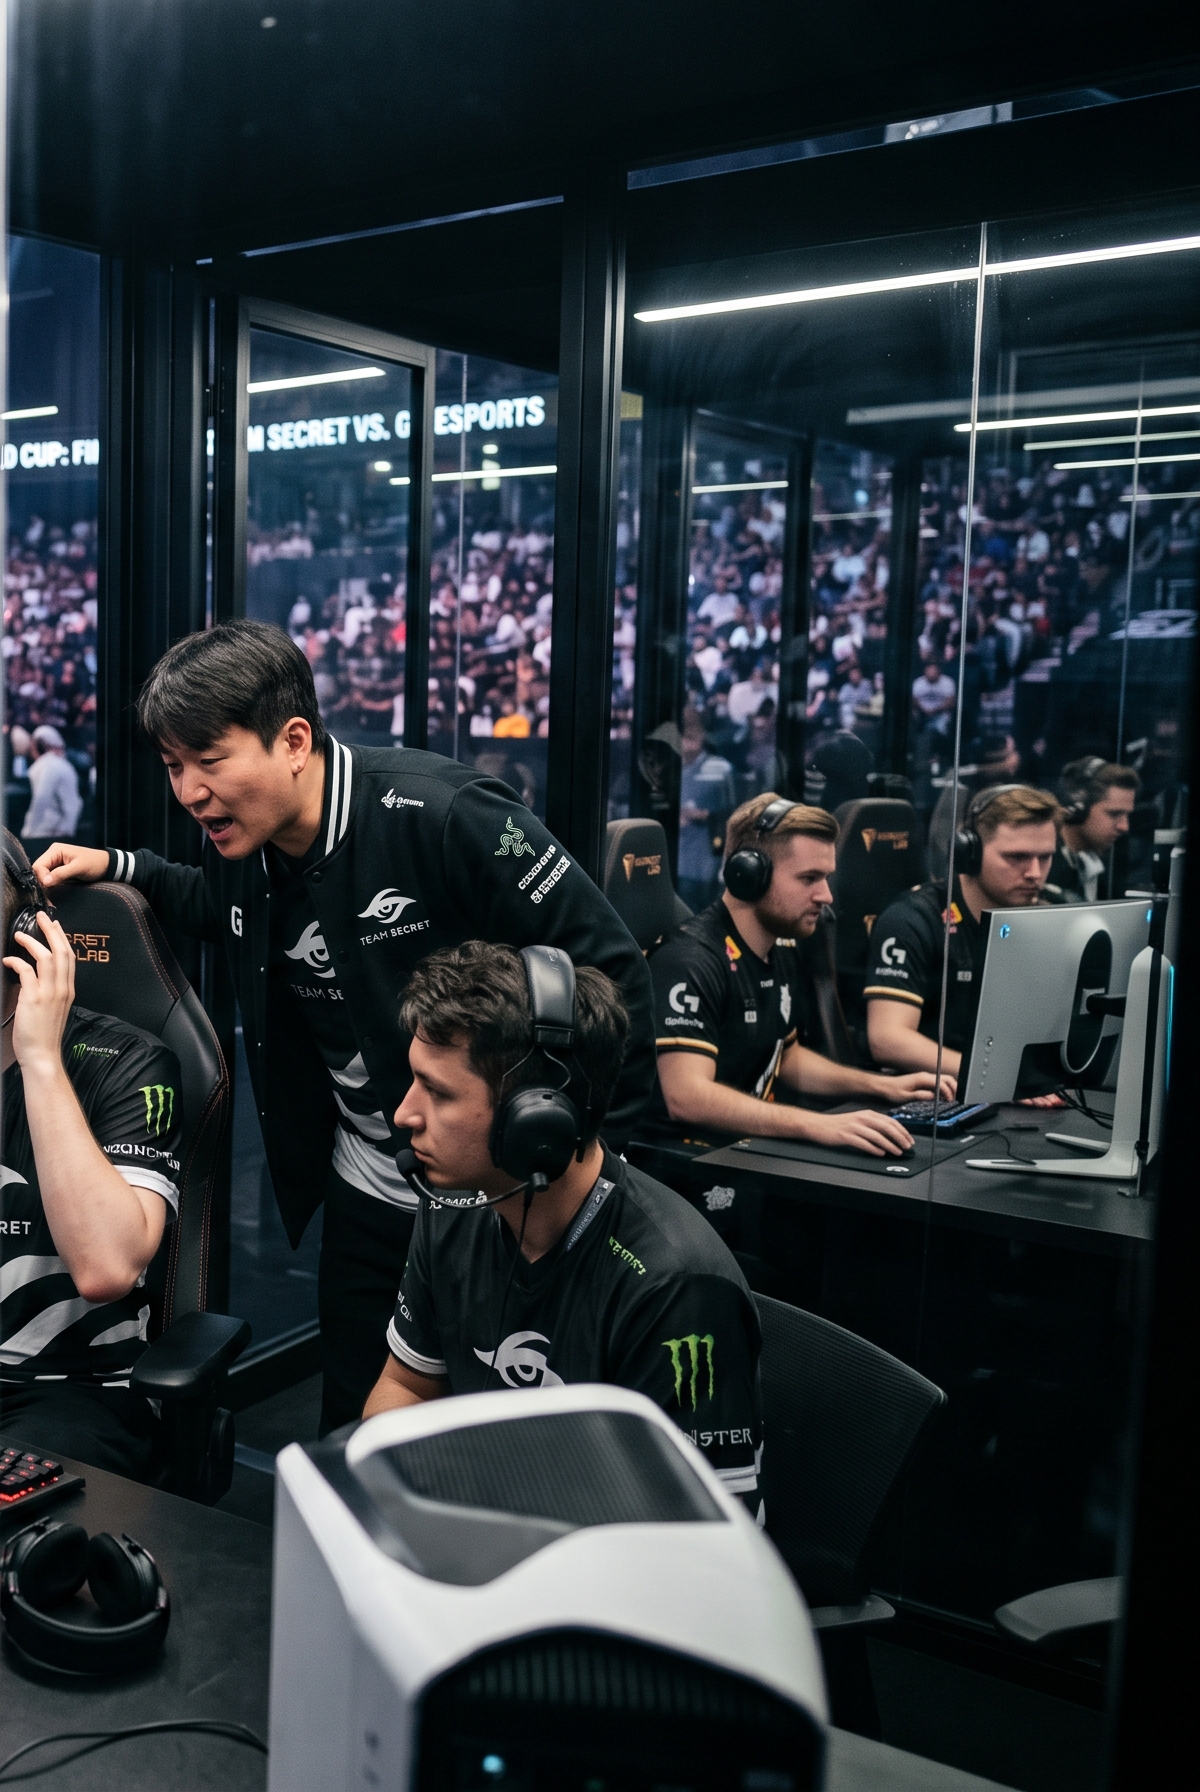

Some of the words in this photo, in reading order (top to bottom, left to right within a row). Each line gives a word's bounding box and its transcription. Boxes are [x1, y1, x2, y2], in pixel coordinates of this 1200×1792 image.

[266, 415, 351, 451] SECRET
[352, 412, 391, 443] VS.
[433, 395, 546, 435] ESPORTS
[19, 440, 70, 469] CUP:
[360, 930, 389, 946] TEAM
[390, 920, 431, 938] SECRET
[290, 984, 326, 999] TEAM
[683, 1428, 753, 1447] NSTER
